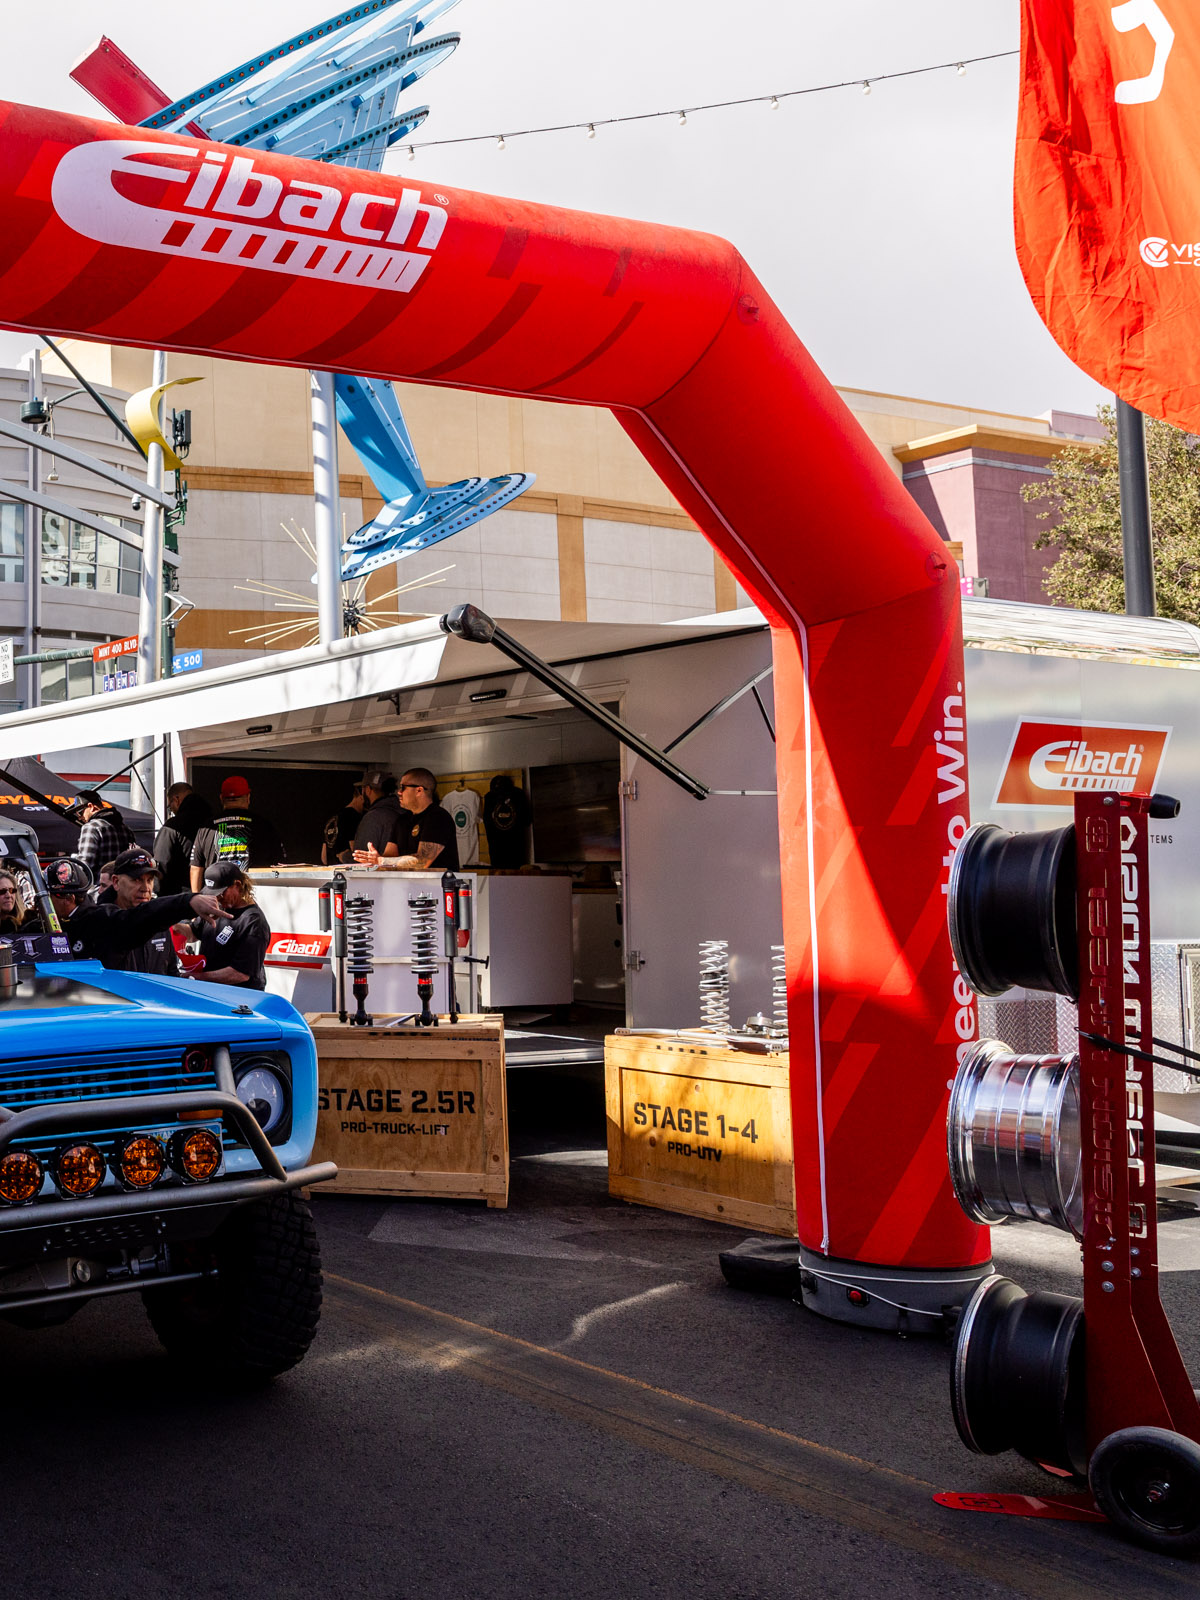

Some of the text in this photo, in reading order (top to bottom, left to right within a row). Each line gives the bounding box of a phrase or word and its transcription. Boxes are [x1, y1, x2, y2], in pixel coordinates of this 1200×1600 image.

[111, 643, 122, 654] 400
[124, 638, 137, 651] BLVD
[184, 654, 200, 667] 500
[104, 674, 135, 691] FREMO
[933, 681, 966, 804] Win.
[1029, 740, 1142, 791] Eibach
[1150, 834, 1173, 844] TEMS
[272, 938, 321, 956] Eibach
[317, 1088, 476, 1114] STAGE 2.5R
[341, 1122, 450, 1136] PRO-TRUCK-LIFT
[633, 1102, 759, 1144] STAGE 1-4
[667, 1141, 722, 1162] PRO-UTV
